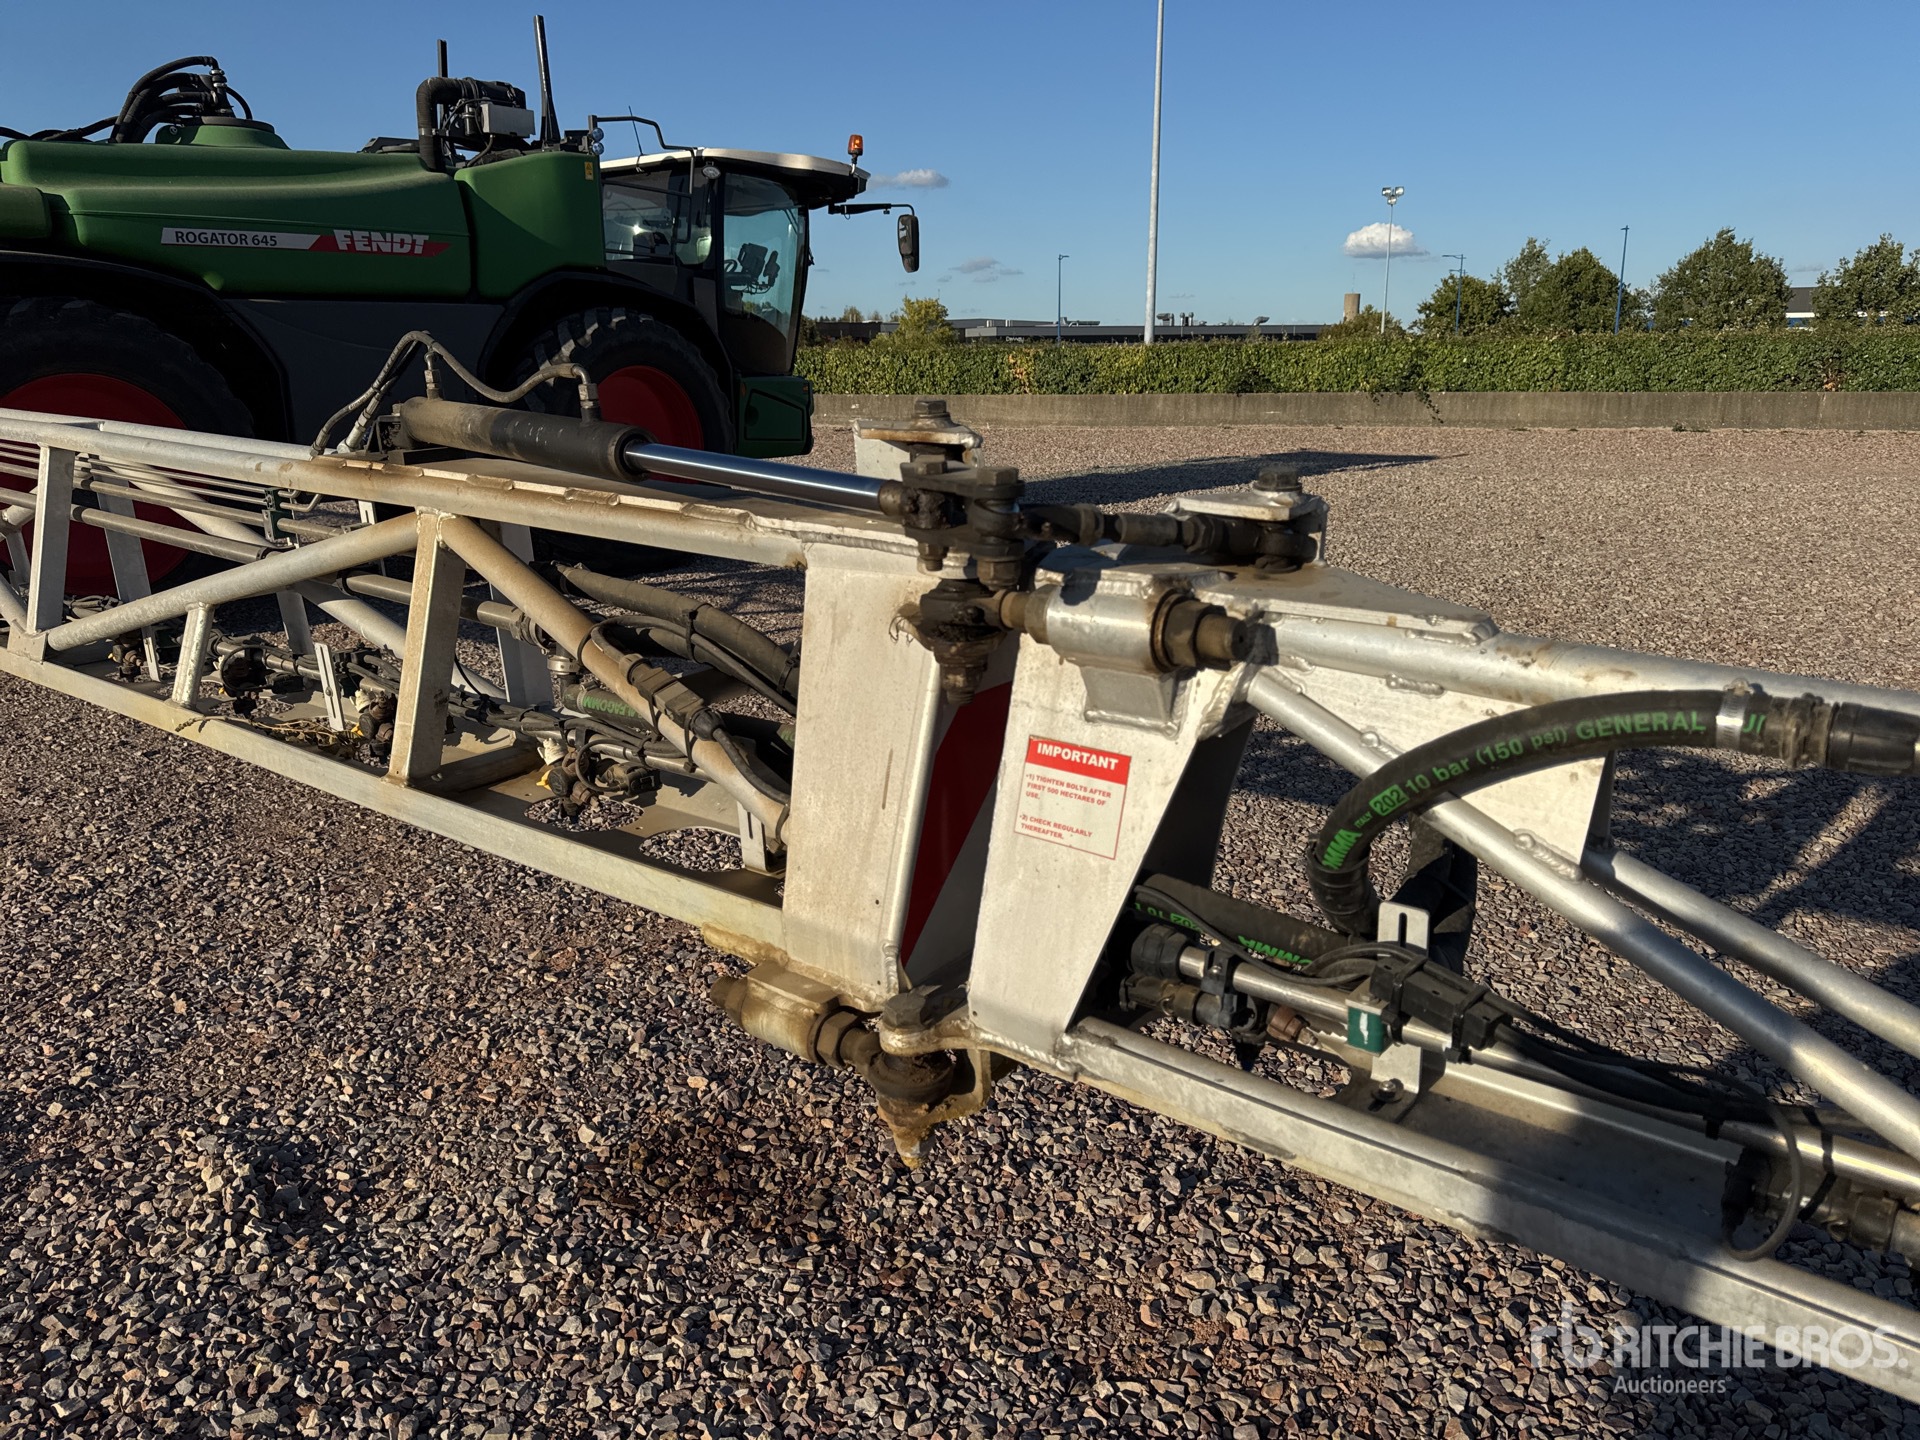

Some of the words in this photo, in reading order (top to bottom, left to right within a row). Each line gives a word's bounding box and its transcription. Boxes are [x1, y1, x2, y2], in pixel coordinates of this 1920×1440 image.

[174, 230, 249, 246] ROGATOR
[251, 233, 278, 247] 645
[333, 229, 430, 255] FENDT
[1037, 743, 1119, 770] IMPORTANT
[1027, 782, 1046, 792] FIRST
[1046, 787, 1059, 795] 500
[1060, 790, 1095, 804] HECTARES
[1035, 775, 1065, 788] TIGHTEN
[1065, 782, 1088, 793] BOLTS
[1089, 788, 1111, 799] AFTER
[1321, 828, 1363, 870] MMA
[1370, 785, 1408, 816] 202
[1405, 774, 1431, 793] 10
[1432, 757, 1470, 782] bar
[1476, 737, 1524, 765] (150
[1530, 726, 1568, 749] psi)
[1575, 711, 1707, 740] GENERAL
[1021, 823, 1064, 839] THEREAFTER.
[1029, 816, 1052, 828] CHECK
[1053, 822, 1093, 838] REGULARLY
